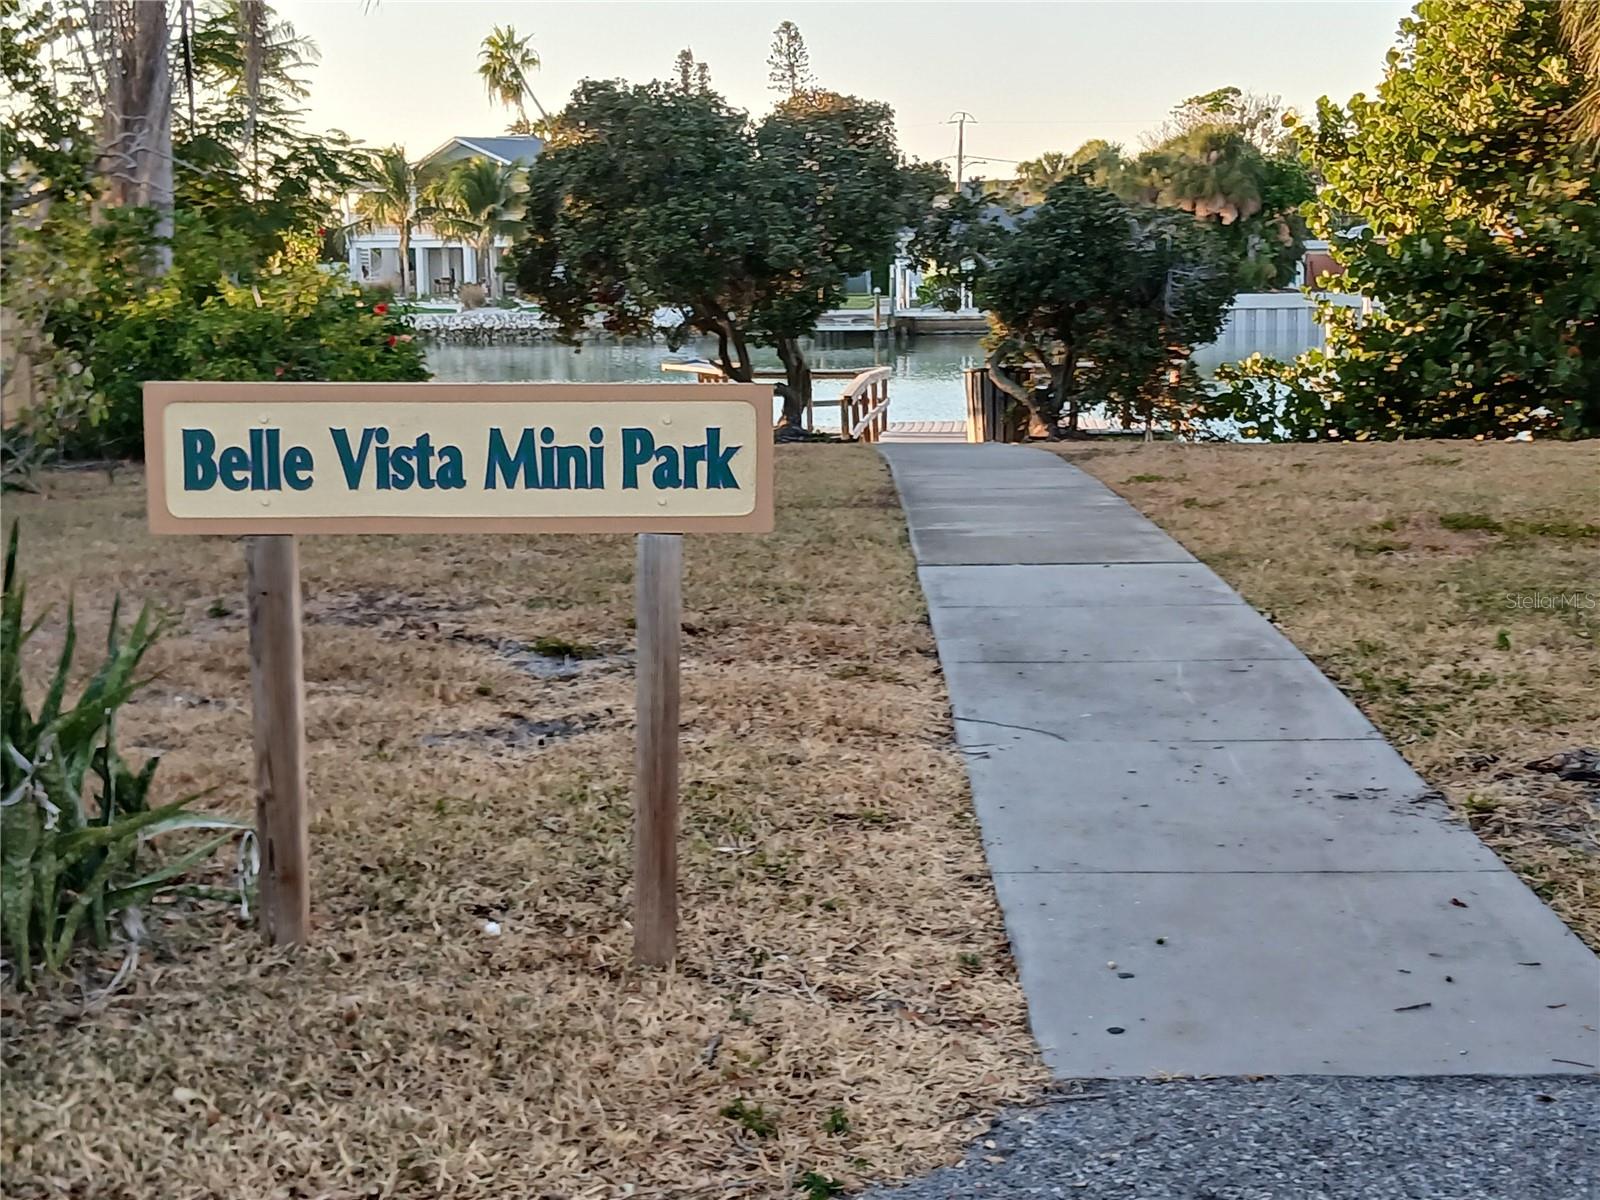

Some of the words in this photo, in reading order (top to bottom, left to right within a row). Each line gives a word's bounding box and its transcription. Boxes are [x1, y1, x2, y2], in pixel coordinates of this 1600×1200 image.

[182, 427, 314, 491] Belle
[329, 426, 467, 491] Vista
[484, 426, 605, 490] Mini
[621, 427, 743, 490] Park
